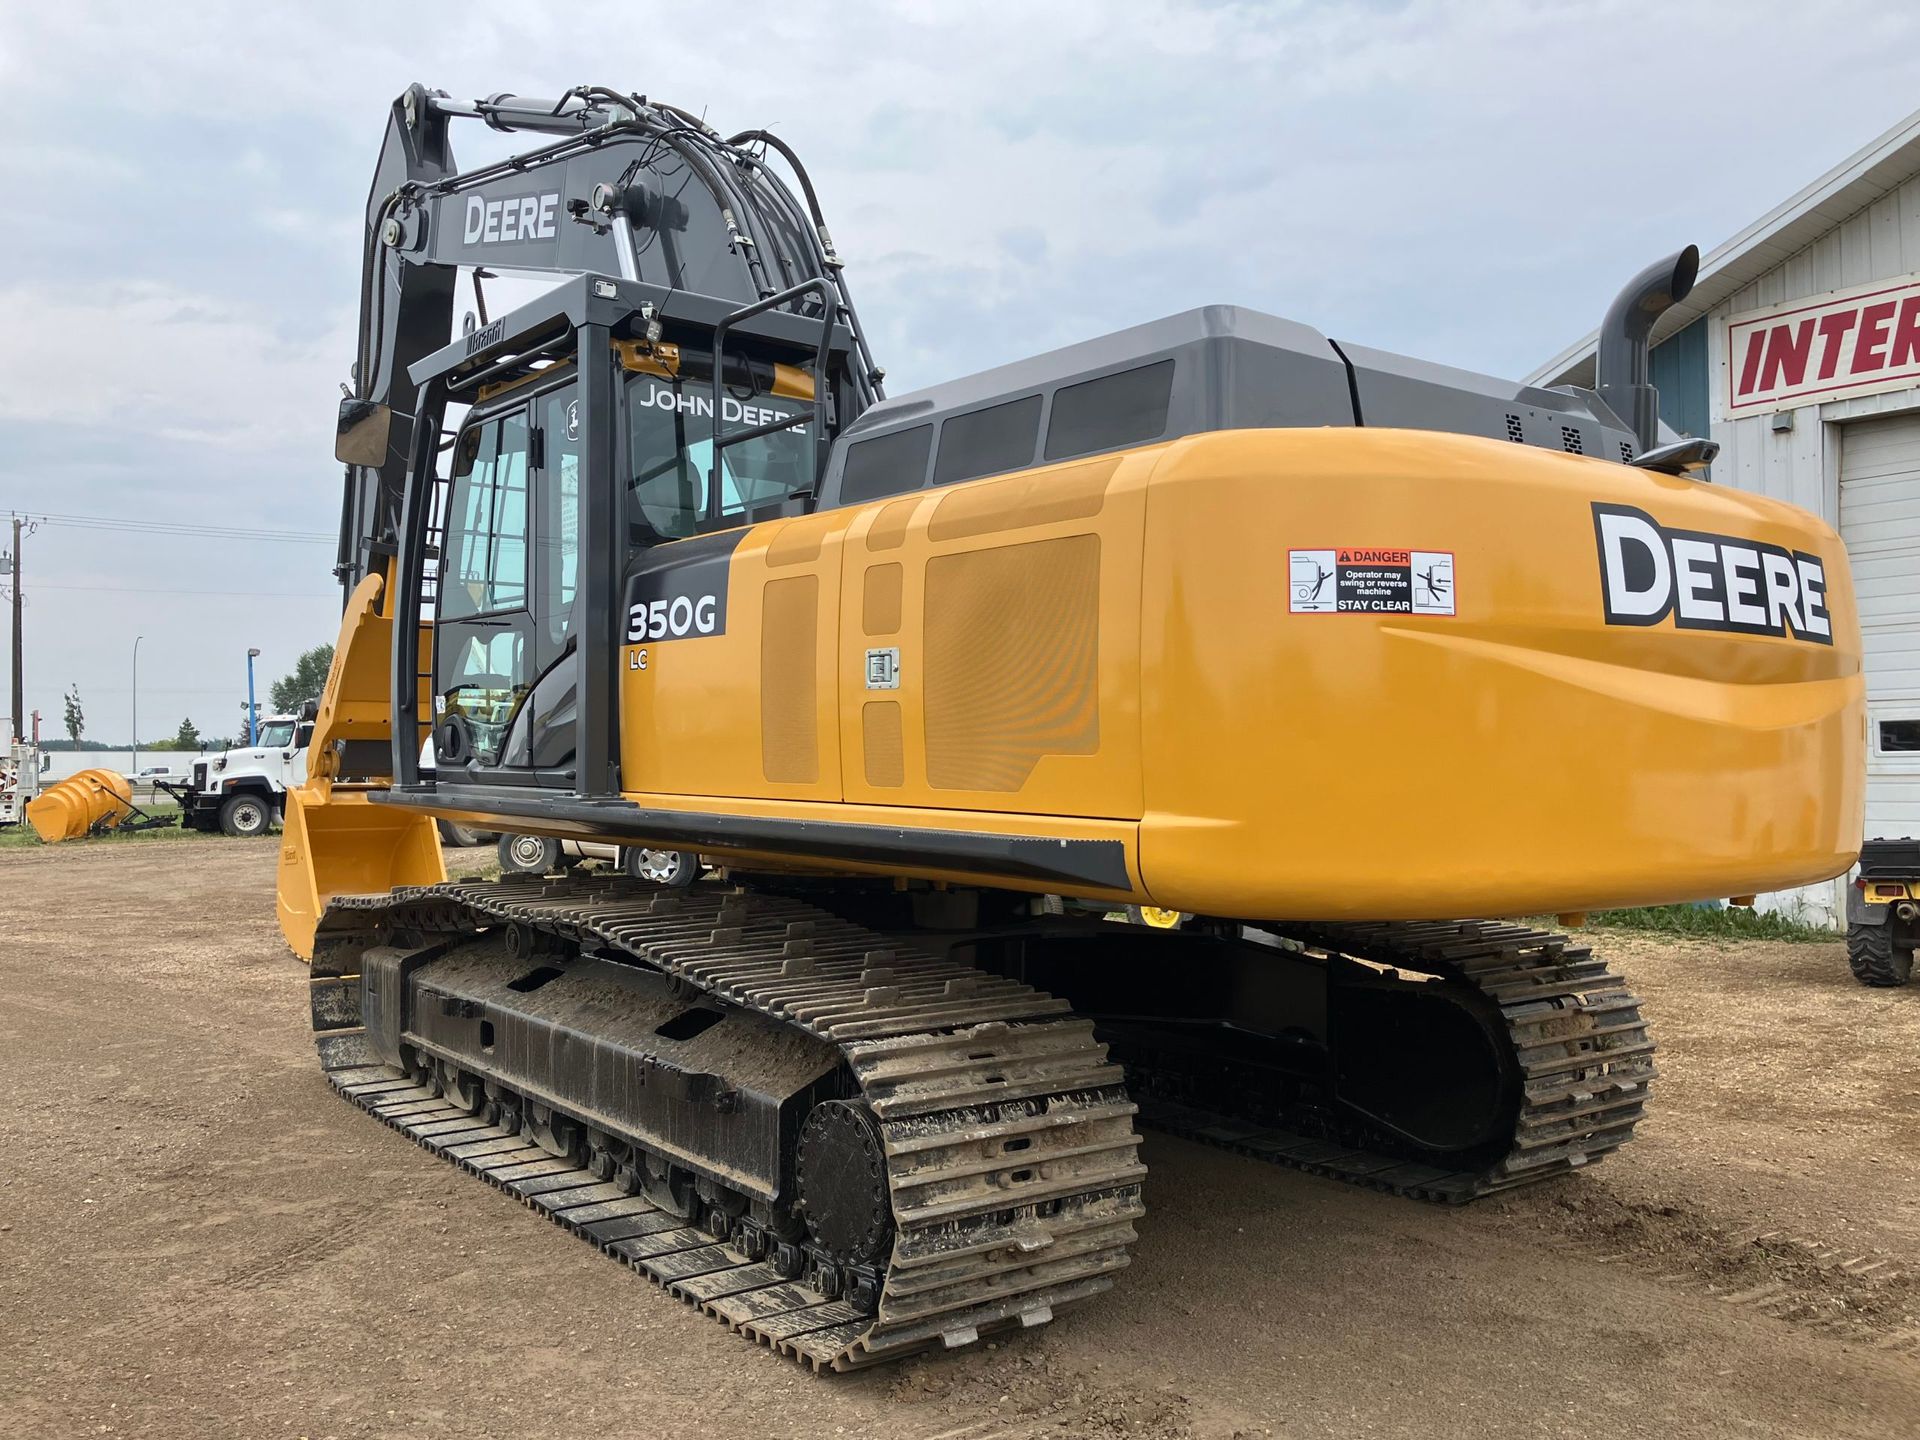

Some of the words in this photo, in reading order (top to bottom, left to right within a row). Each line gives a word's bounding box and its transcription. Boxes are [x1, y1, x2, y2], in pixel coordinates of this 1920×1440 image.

[463, 193, 559, 244] DEERE
[1738, 295, 1920, 396] INTER
[640, 383, 714, 418] JOHN
[1354, 551, 1409, 563] DANGER
[1340, 579, 1365, 588] swing
[1346, 570, 1382, 580] Operator
[1384, 572, 1401, 581] may
[1599, 513, 1830, 636] DEERE
[1356, 588, 1391, 596] machine
[1338, 600, 1369, 611] STAY
[1371, 601, 1410, 612] CLEAR
[628, 595, 716, 642] 350G
[630, 649, 647, 670] LC
